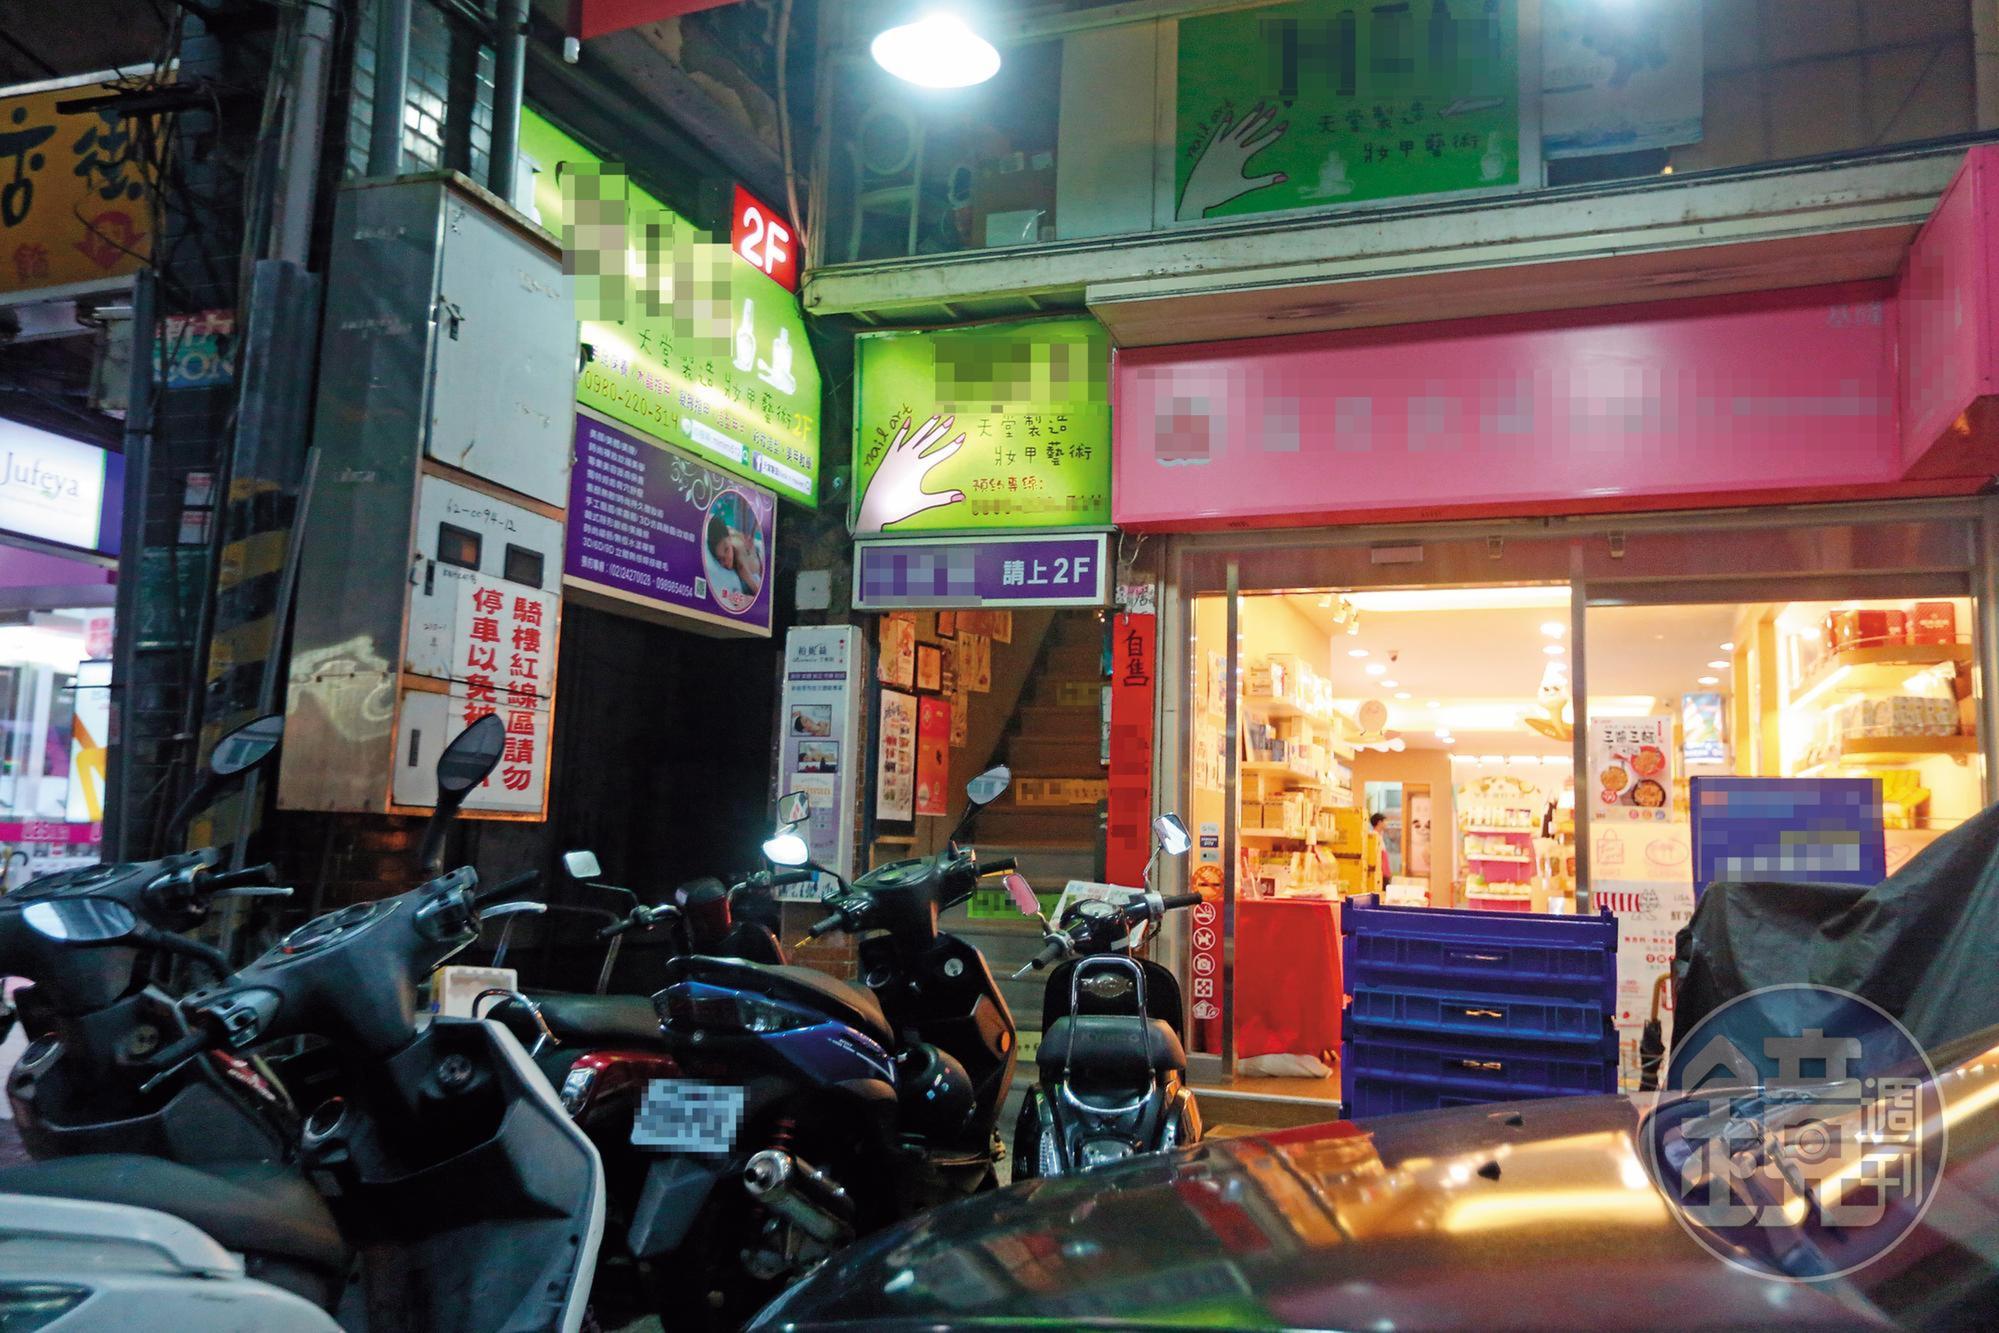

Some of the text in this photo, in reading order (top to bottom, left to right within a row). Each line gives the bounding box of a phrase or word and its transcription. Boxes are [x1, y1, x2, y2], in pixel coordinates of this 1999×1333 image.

[1319, 101, 1425, 134] 天堂製造
[741, 206, 789, 274] 2F
[638, 329, 715, 388] 天堂製造
[584, 370, 679, 432] 0980-220-314
[977, 415, 1068, 438] 天堂製造
[0, 451, 79, 500] Jufeya
[994, 441, 1092, 466] 妝甲藝術
[1123, 629, 1149, 687] 自售
[503, 597, 543, 791] 騎樓紅線區請勿
